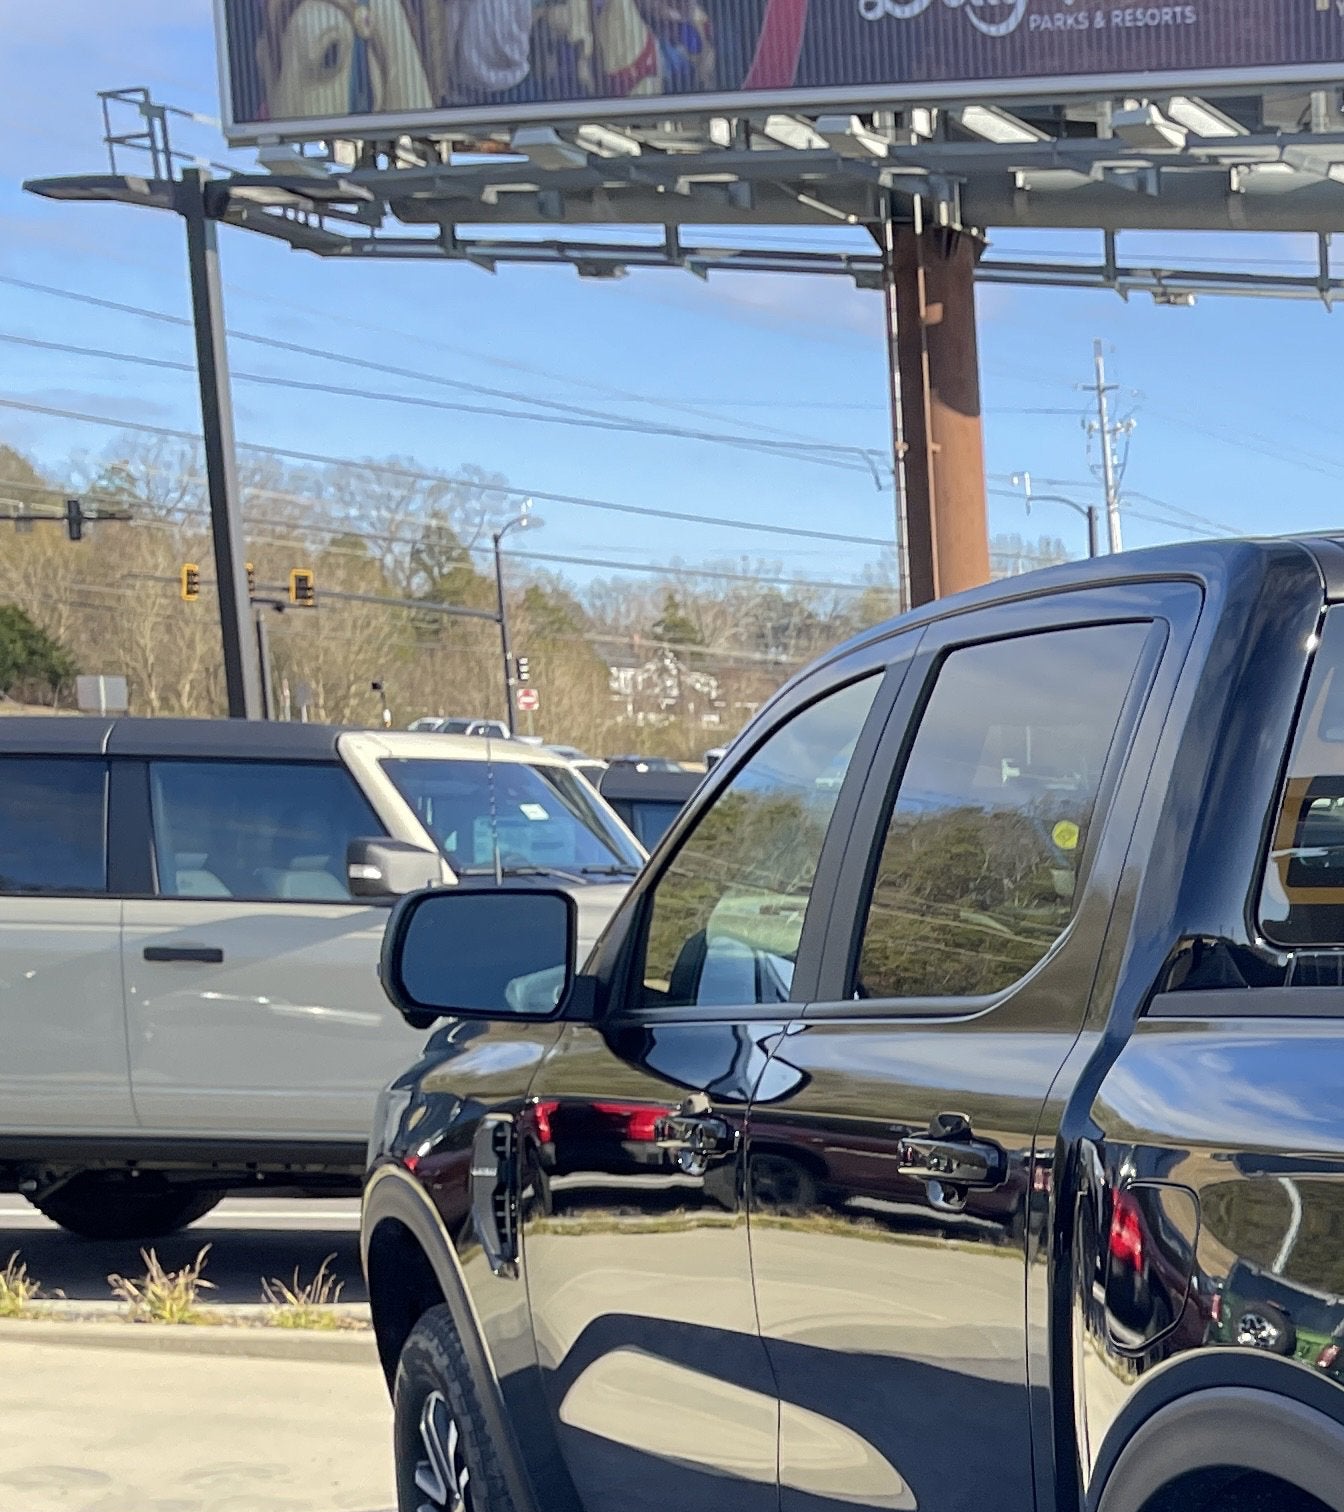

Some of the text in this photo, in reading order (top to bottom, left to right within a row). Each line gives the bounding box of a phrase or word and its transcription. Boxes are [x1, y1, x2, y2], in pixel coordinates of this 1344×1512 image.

[1029, 11, 1090, 32] PARKS
[1093, 10, 1106, 29] &
[1111, 5, 1198, 28] RESORTS
